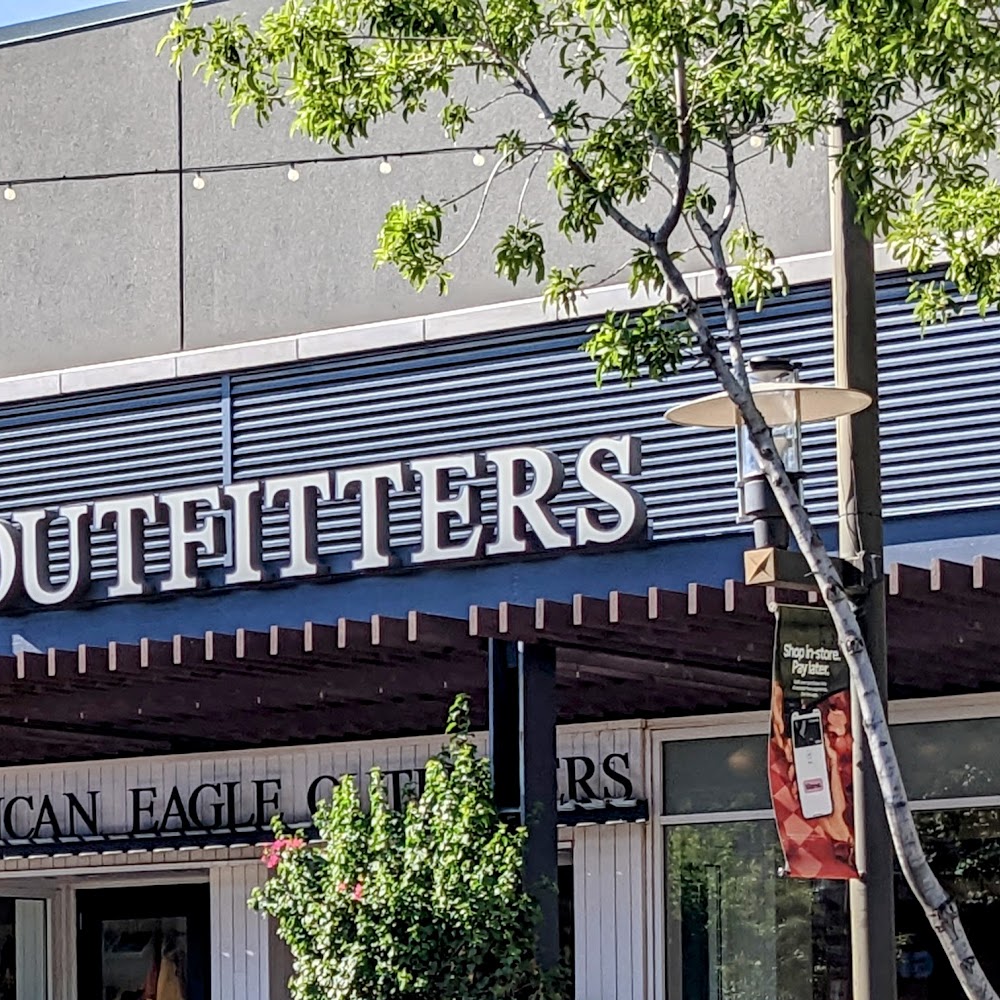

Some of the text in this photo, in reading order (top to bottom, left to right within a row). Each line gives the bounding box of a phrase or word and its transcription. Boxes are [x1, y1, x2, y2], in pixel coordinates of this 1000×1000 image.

[783, 644, 841, 661] Shop in-store.
[792, 660, 830, 677] Pay later.
[129, 779, 284, 833] EAGLE
